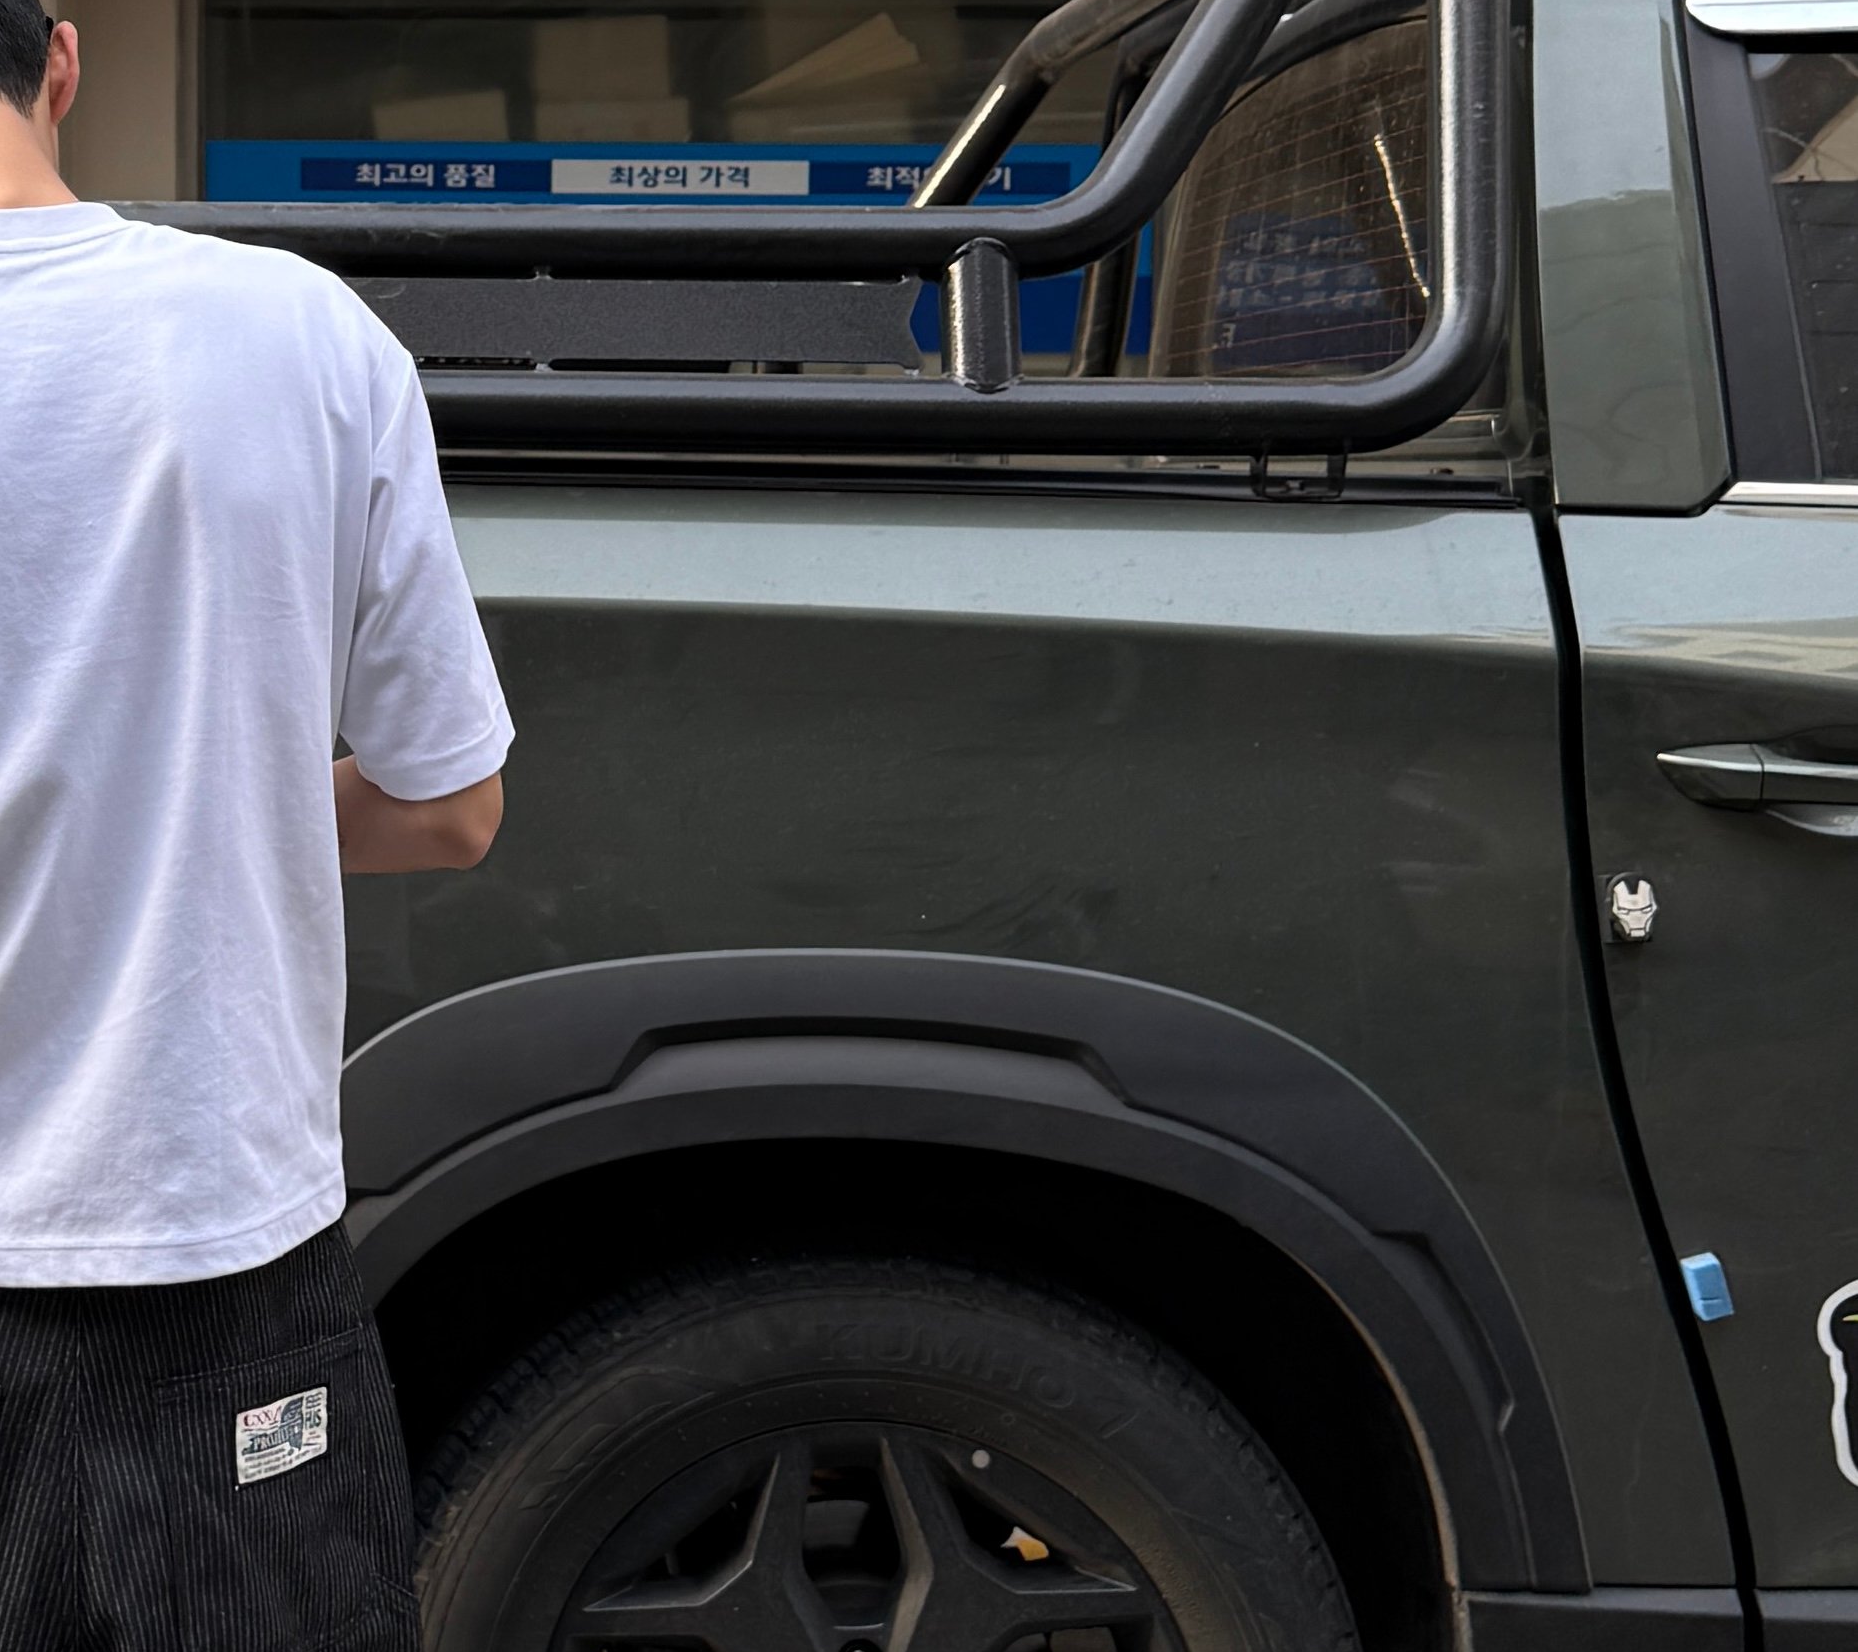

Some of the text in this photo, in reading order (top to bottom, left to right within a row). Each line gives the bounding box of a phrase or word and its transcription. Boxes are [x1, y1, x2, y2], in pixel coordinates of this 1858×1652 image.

[355, 163, 495, 188] 최고의 품질
[609, 164, 751, 189] 최상의 가격
[867, 166, 931, 190] 최적
[814, 1317, 1076, 1409] KUMHO
